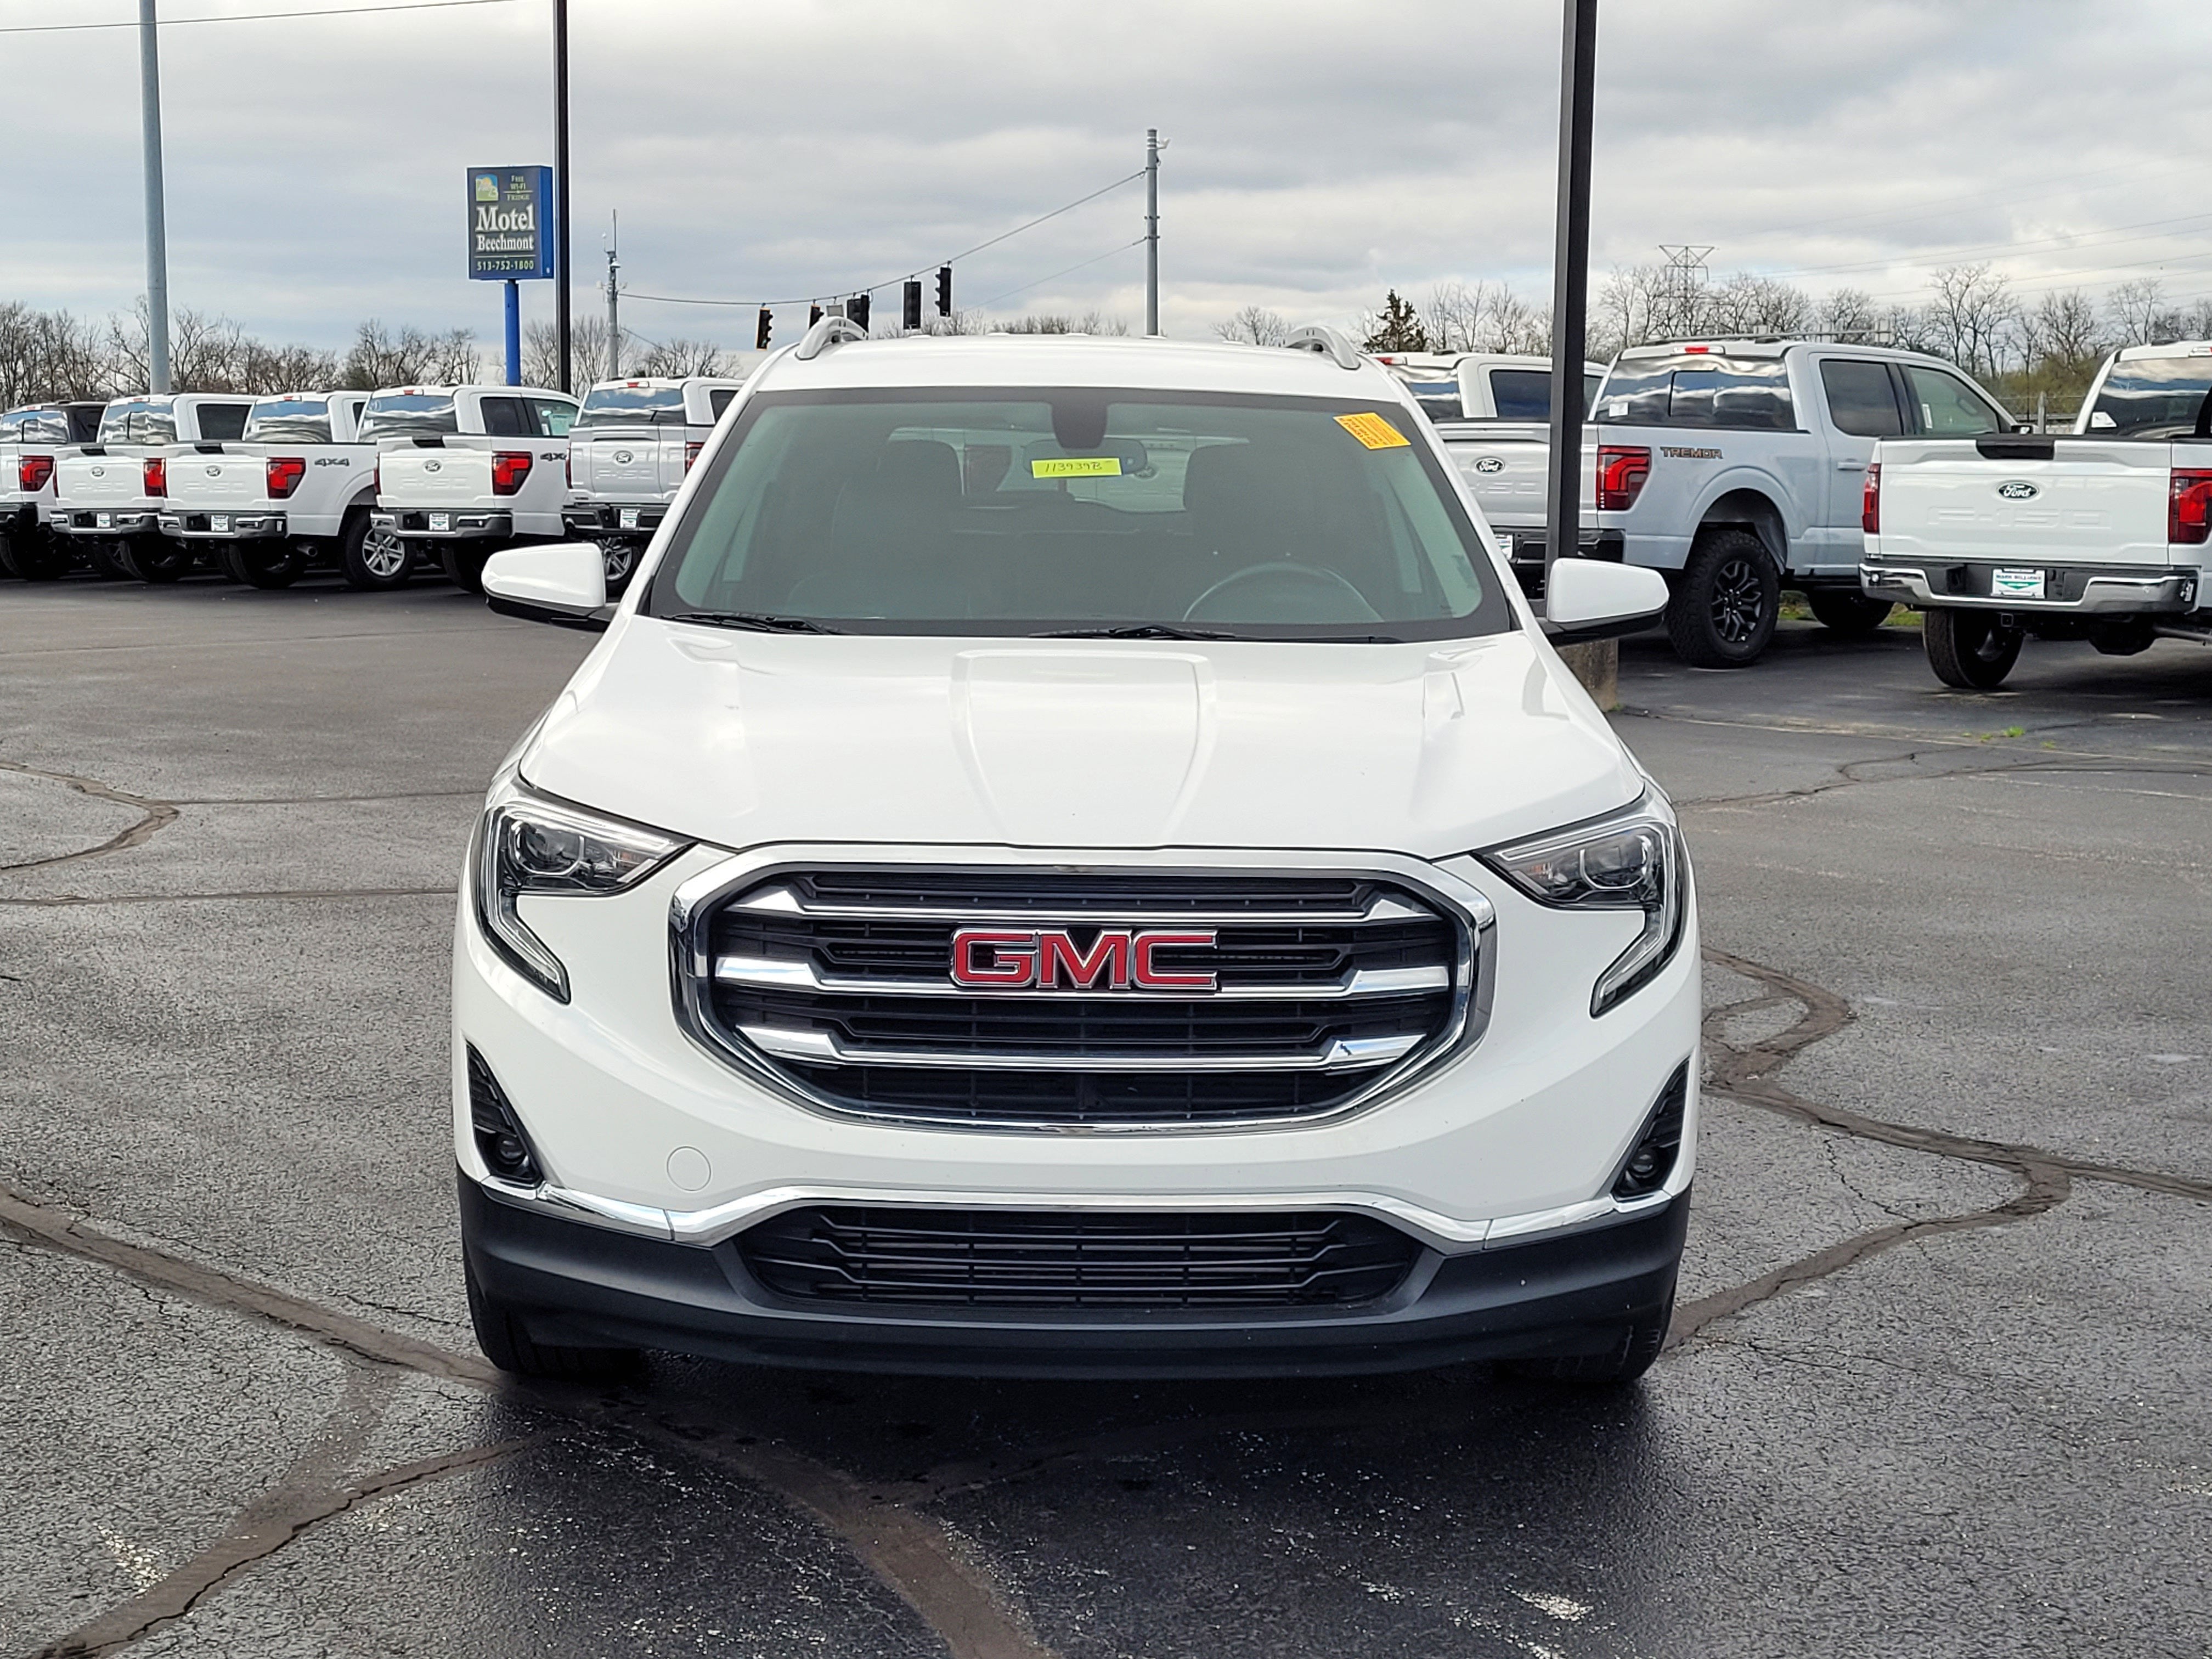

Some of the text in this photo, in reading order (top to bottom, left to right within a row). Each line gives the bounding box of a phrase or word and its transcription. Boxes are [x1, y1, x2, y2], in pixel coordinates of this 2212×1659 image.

[475, 204, 535, 232] Motel
[476, 234, 534, 251] Beechmont
[477, 261, 534, 270] 513-752-1800
[1660, 446, 1723, 459] TREMOR
[2003, 484, 2032, 497] Ford
[1927, 506, 2112, 530] F-150
[952, 929, 1218, 990] GMC
